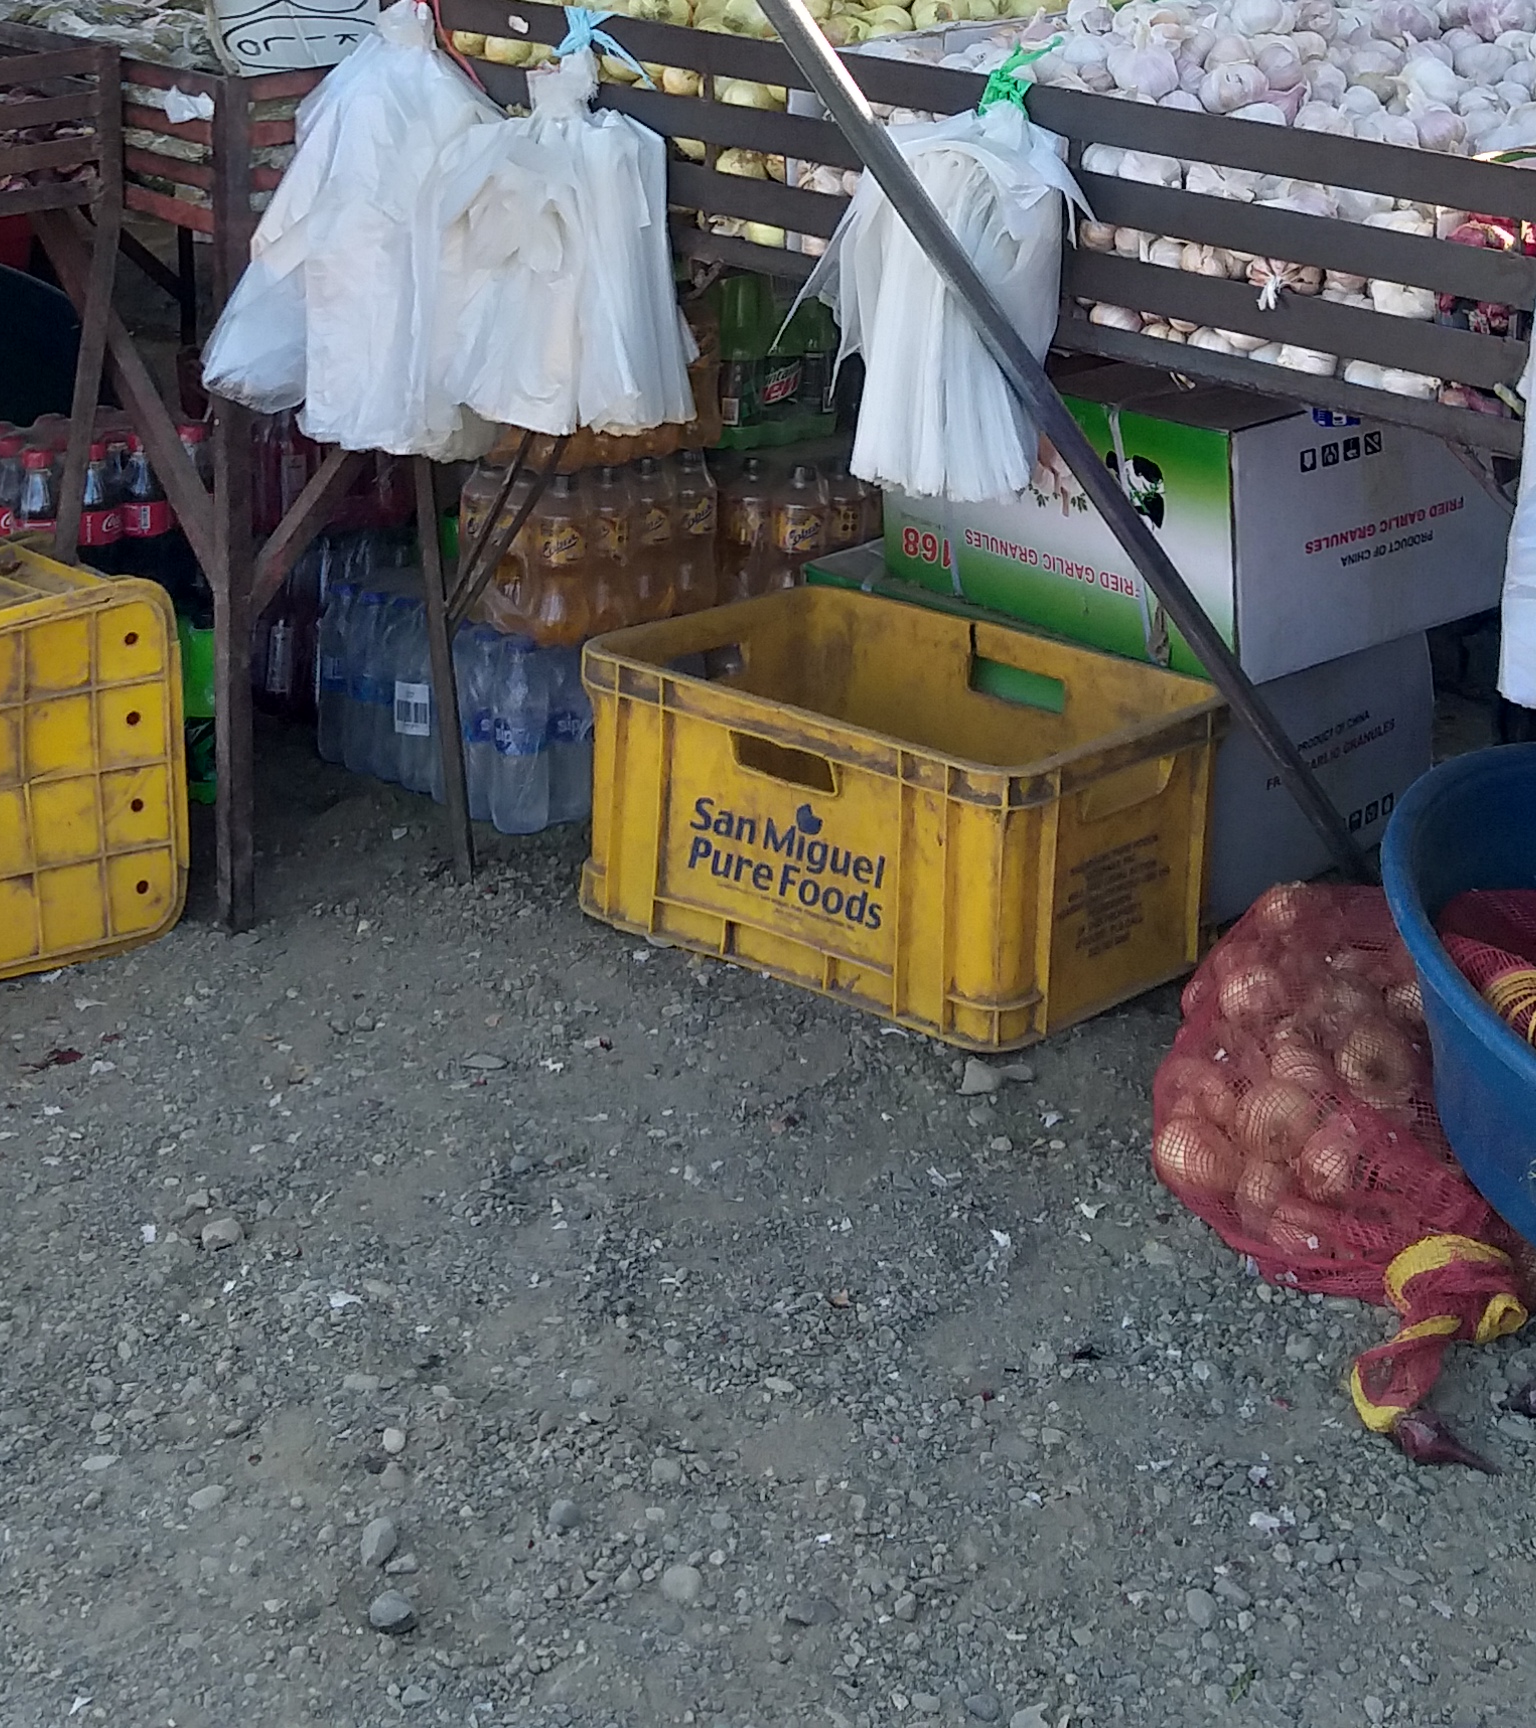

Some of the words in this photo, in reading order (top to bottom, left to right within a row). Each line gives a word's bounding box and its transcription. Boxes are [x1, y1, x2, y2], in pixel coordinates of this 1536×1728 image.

[1379, 508, 1426, 533] GARLIC
[1429, 495, 1464, 518] FRIED
[902, 526, 951, 569] 168
[964, 527, 1039, 566] GRANULES
[1304, 523, 1376, 555] GRANULES
[1373, 544, 1387, 559] OF
[1389, 529, 1434, 554] PRODUCT
[1043, 552, 1095, 584] GARLIC
[1340, 548, 1371, 568] CHINA
[689, 796, 757, 845] San
[762, 817, 886, 889] Miguel
[687, 835, 774, 892] Pure
[778, 863, 883, 930] Foods
